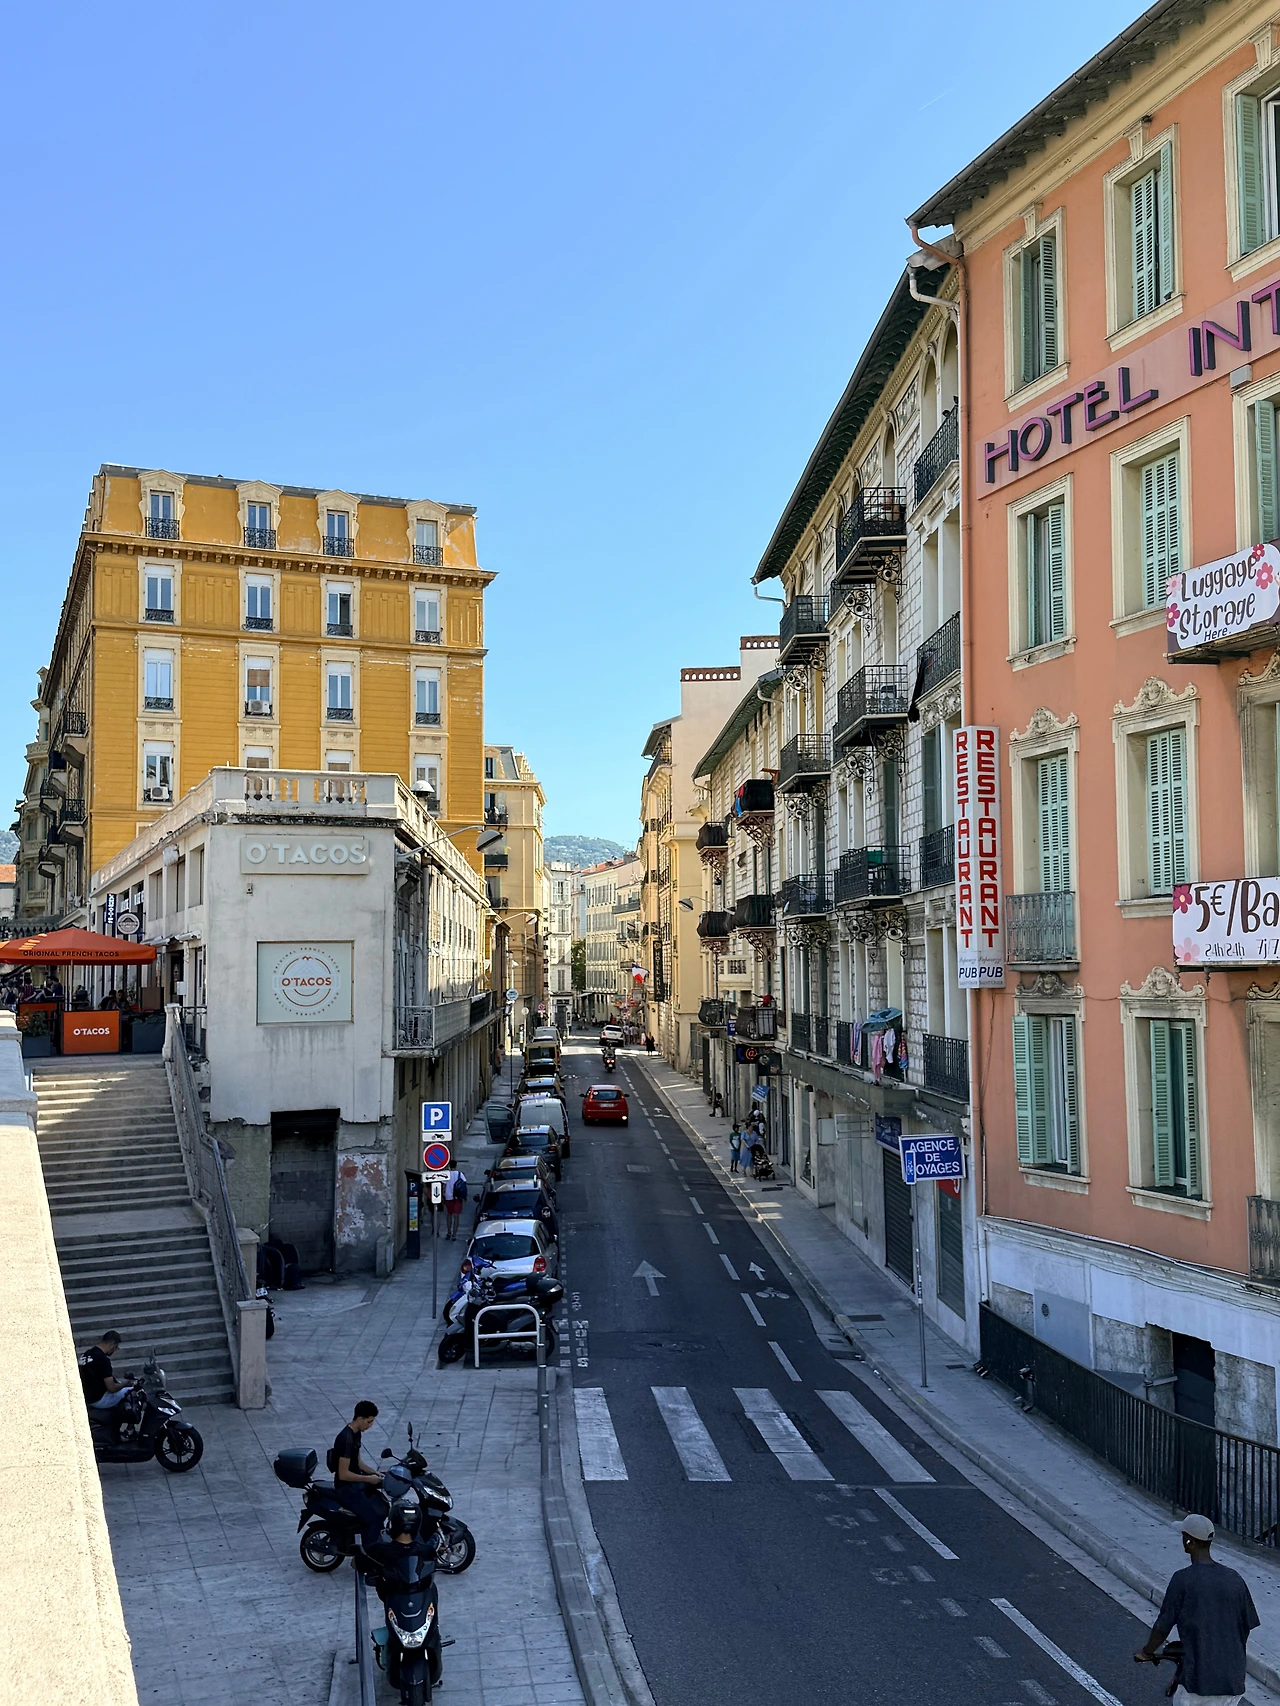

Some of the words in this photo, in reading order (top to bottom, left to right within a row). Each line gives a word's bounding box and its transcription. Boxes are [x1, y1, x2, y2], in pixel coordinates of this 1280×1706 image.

[984, 366, 1159, 484] HOTEL
[1181, 555, 1257, 602] Luggage
[1179, 592, 1256, 640] Storage
[956, 730, 974, 949] RESTAURANT
[976, 729, 1000, 948] RESTAURANT
[246, 842, 367, 865] O'TACOS
[959, 967, 978, 979] PUB
[979, 966, 1003, 978] PUB
[281, 976, 332, 987] O'TACOS
[73, 1027, 110, 1036] O'TACOS
[430, 1108, 443, 1126] P
[909, 1139, 955, 1153] AGENCE
[925, 1152, 941, 1162] DE
[914, 1161, 960, 1176] OYAGES
